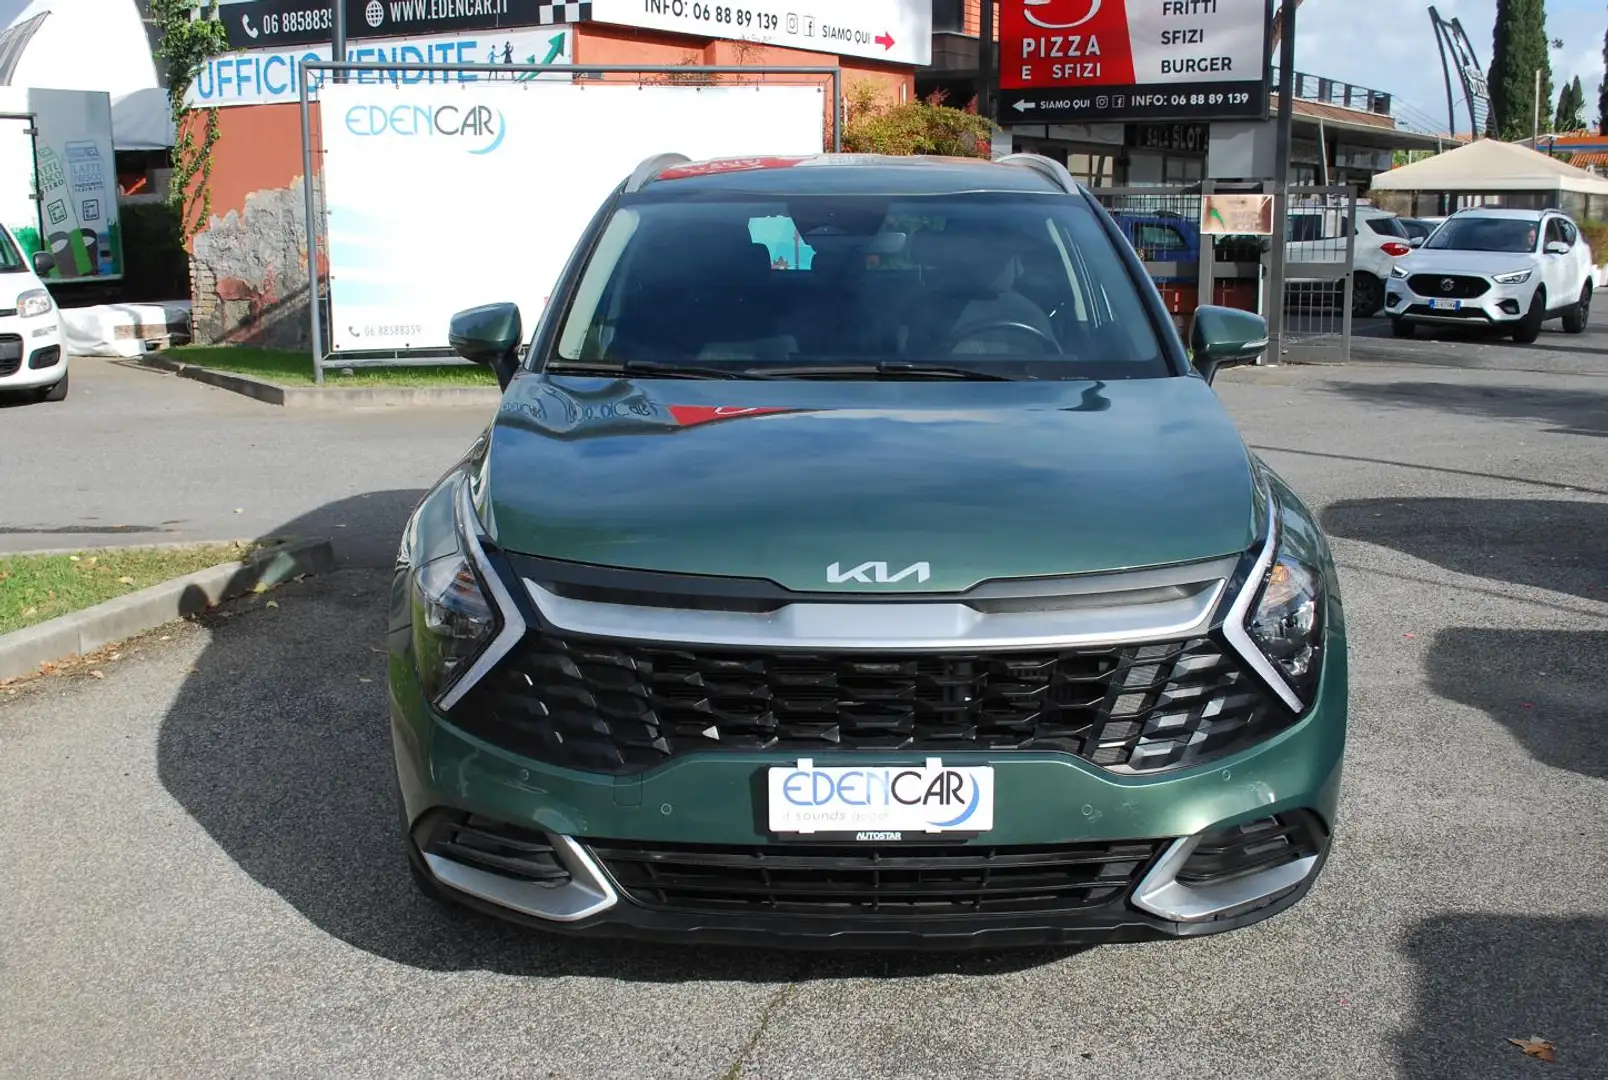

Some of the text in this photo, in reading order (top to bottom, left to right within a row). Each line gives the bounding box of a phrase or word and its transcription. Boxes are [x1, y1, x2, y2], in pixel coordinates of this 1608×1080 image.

[645, 0, 778, 30] INFO: 06 88 89 139
[1163, 0, 1216, 15] FRITTI
[263, 15, 279, 35] 06
[822, 25, 871, 45] SIAMO QUI
[1161, 29, 1203, 45] SFIZI
[1023, 35, 1100, 58] PIZZA
[197, 41, 478, 99] UFFICIO VENDITE
[1022, 62, 1101, 79] E SFIZI
[1161, 57, 1232, 74] BURGER
[1040, 99, 1090, 110] SIAMO QUI
[1131, 93, 1249, 106] INFO: 06 88 89 139
[345, 104, 494, 136] EDENCAR
[826, 561, 931, 583] KIA
[783, 771, 965, 805] EDENCAR
[795, 810, 846, 821] sounds
[856, 832, 902, 841] AUTOSTAR
